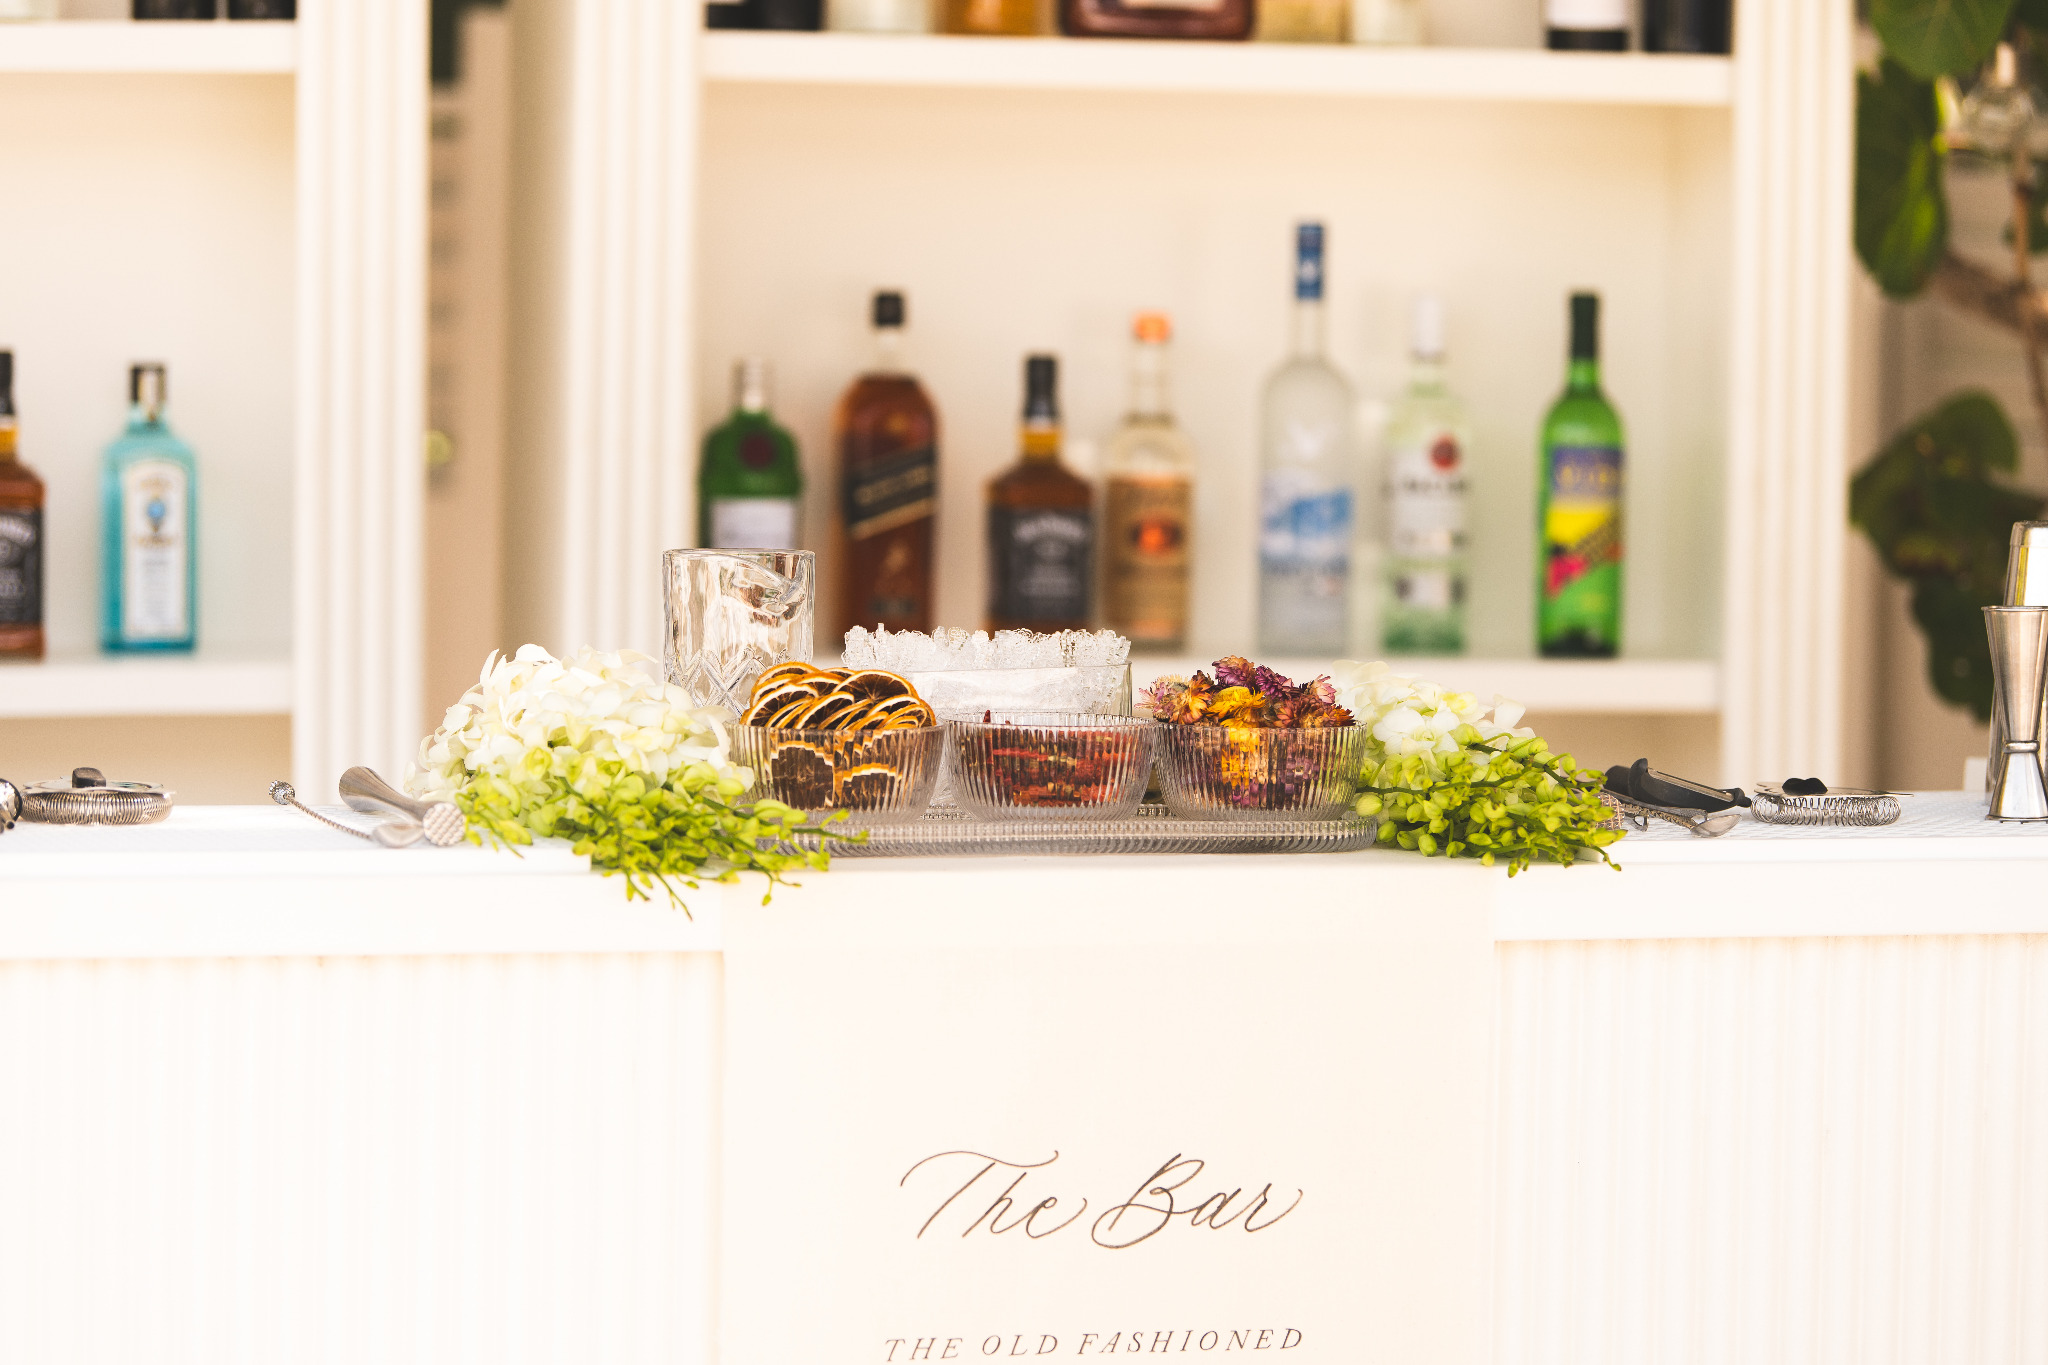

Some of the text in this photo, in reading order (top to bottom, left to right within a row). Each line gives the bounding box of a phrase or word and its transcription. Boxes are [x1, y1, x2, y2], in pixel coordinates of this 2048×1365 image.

[900, 1150, 1304, 1249] The Bar
[884, 1328, 1304, 1362] THE OLD FASHIONED
